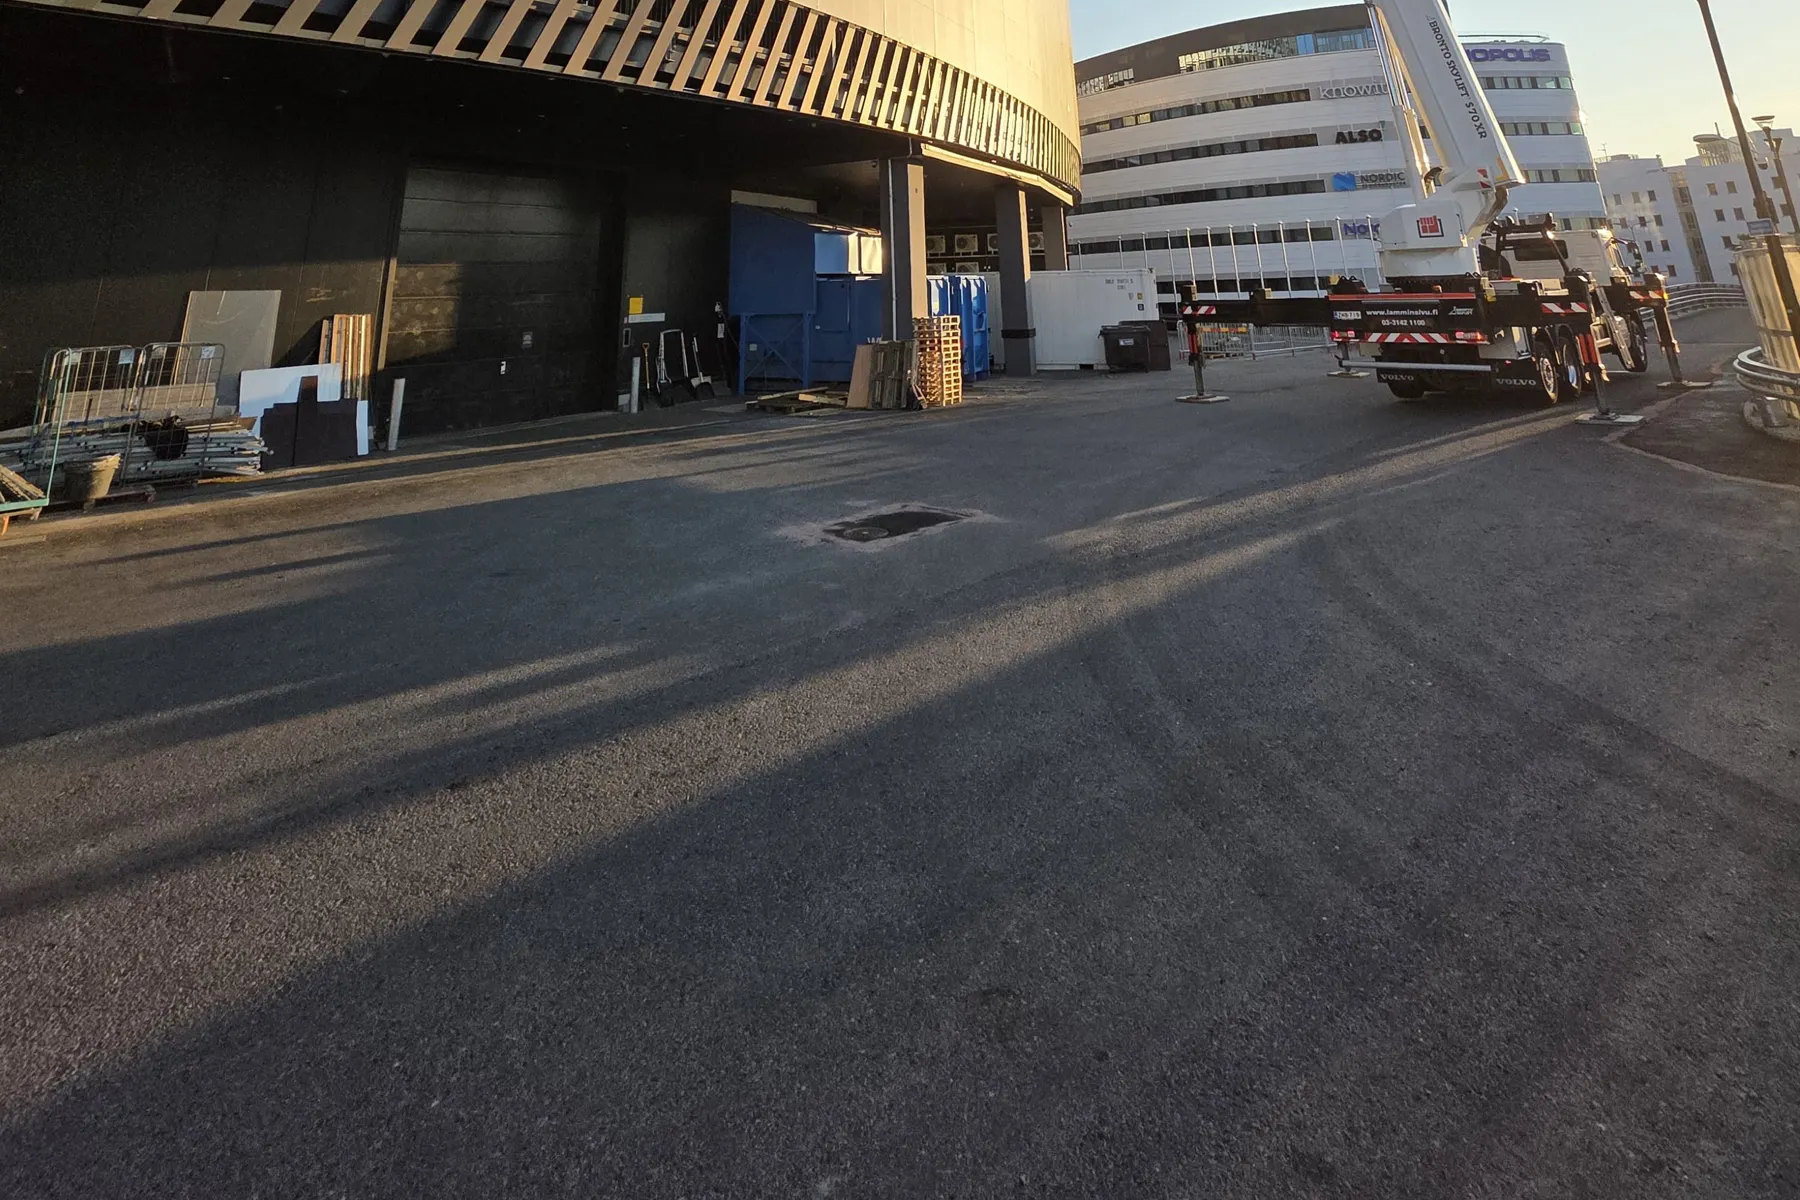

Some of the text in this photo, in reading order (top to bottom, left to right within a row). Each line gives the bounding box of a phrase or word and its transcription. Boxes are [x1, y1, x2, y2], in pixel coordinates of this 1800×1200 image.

[1429, 19, 1452, 60] BRONTO
[1446, 59, 1470, 98] SKYLIFT
[1335, 128, 1383, 144] ALSO
[1361, 172, 1406, 184] NORDIC
[1380, 373, 1414, 381] VOLVO
[1496, 378, 1537, 386] VOLVO
